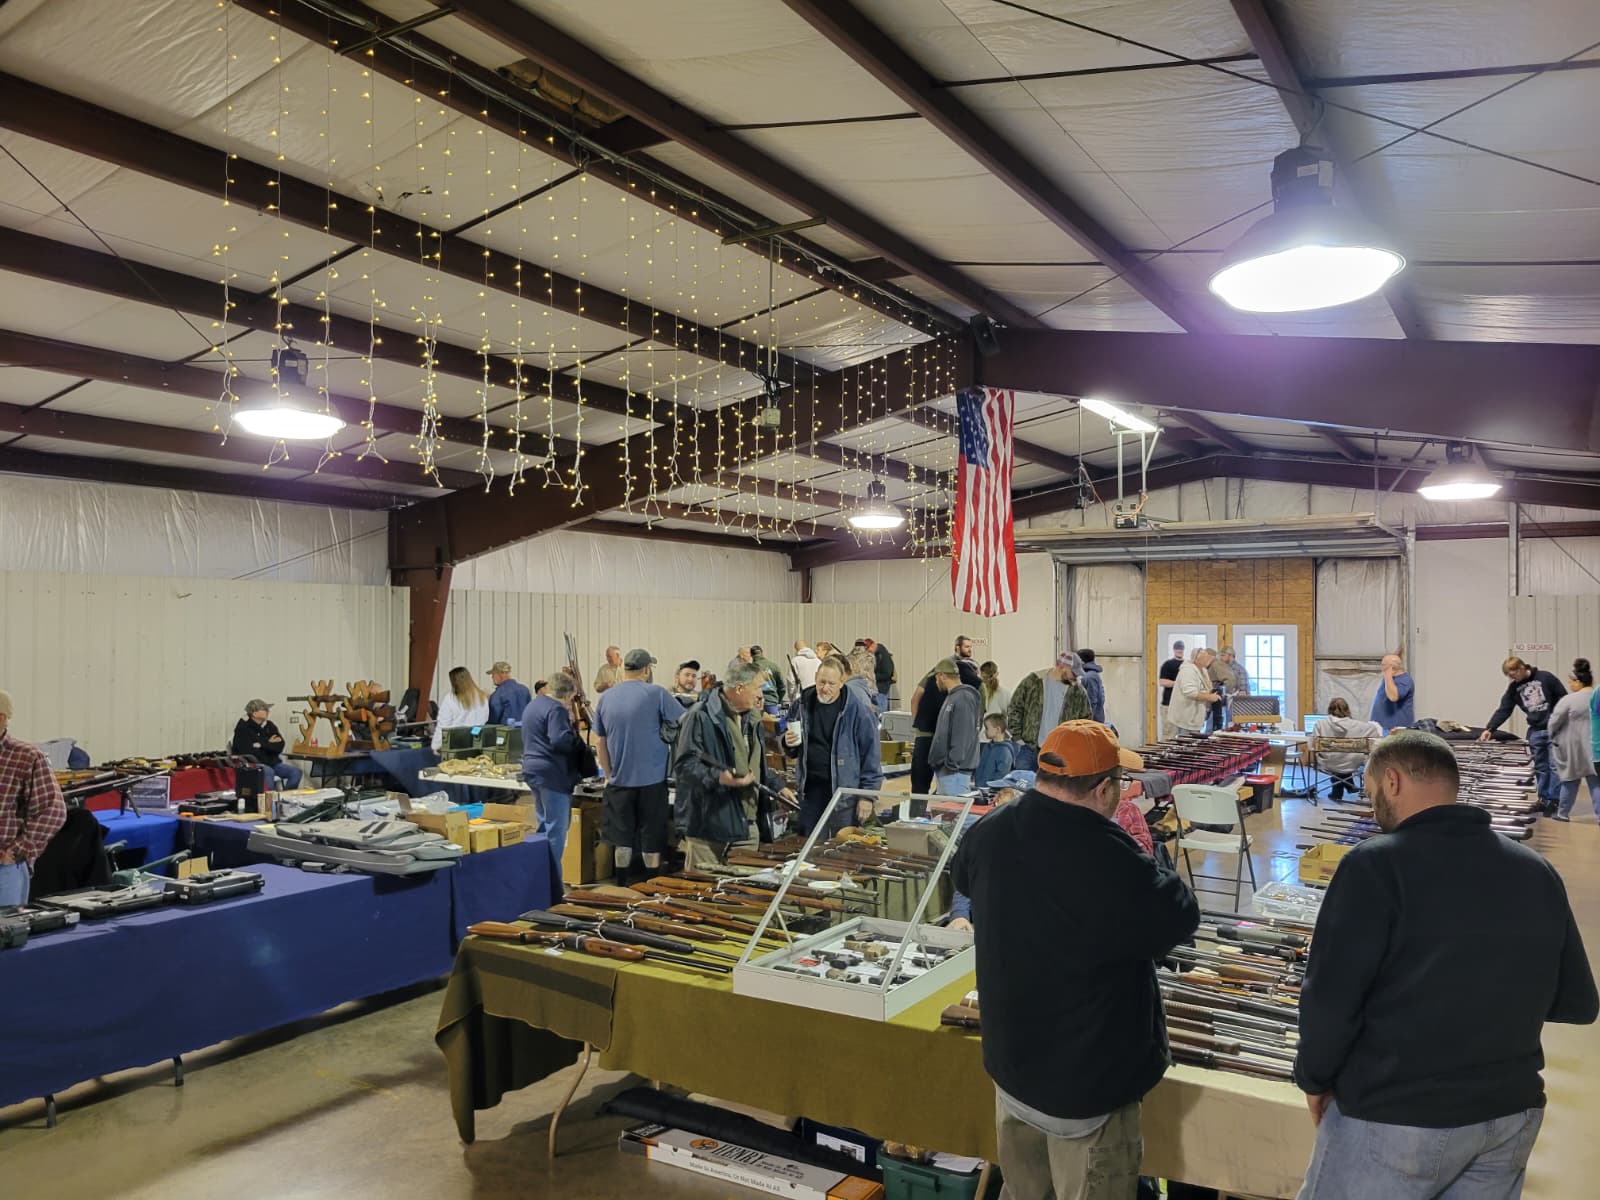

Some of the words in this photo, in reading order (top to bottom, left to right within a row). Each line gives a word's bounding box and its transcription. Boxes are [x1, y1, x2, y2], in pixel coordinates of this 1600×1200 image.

[711, 1144, 768, 1165] HENRY
[689, 1162, 705, 1171] Made
[751, 1178, 764, 1187] Made
